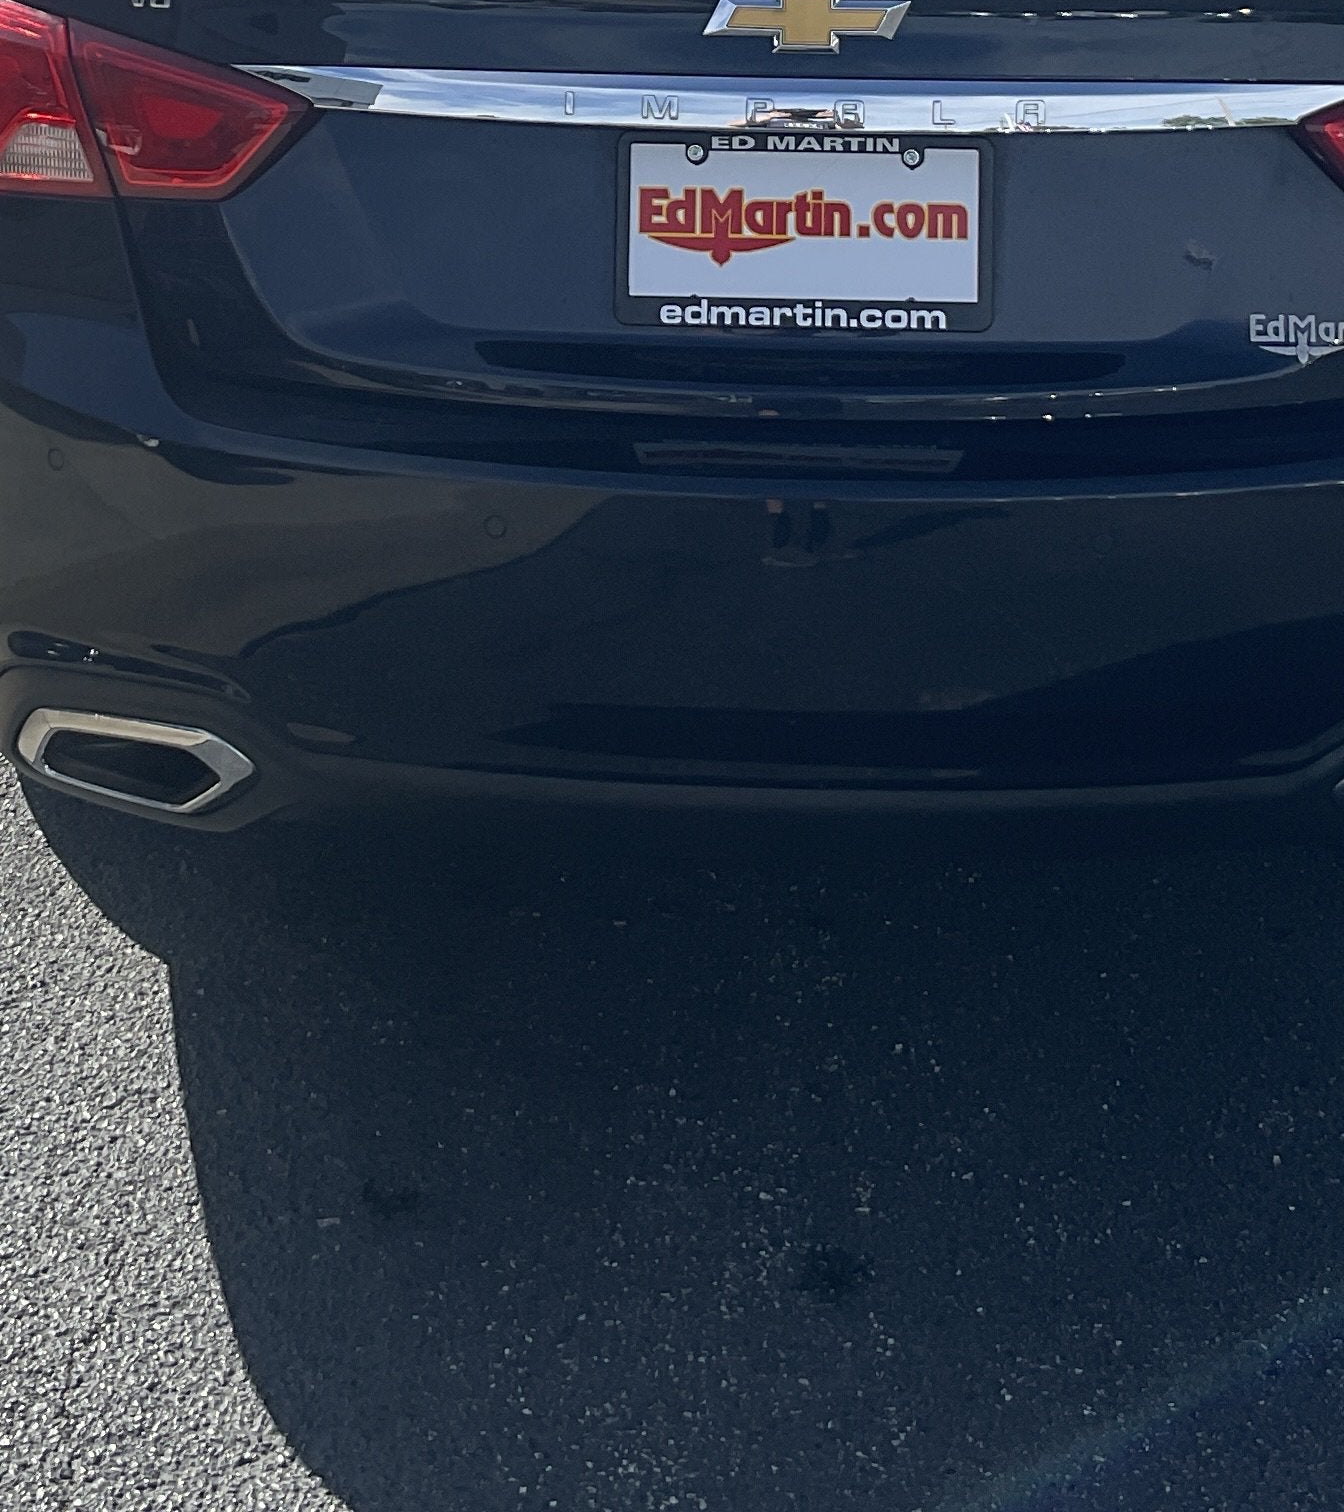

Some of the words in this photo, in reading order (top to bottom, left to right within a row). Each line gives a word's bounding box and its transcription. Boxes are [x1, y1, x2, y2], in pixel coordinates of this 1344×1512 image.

[563, 90, 1047, 126] IMPALA
[711, 135, 756, 150] ED
[766, 136, 900, 153] MARTIN
[638, 186, 969, 241] EdMartin.com
[659, 299, 947, 331] edmartin.com
